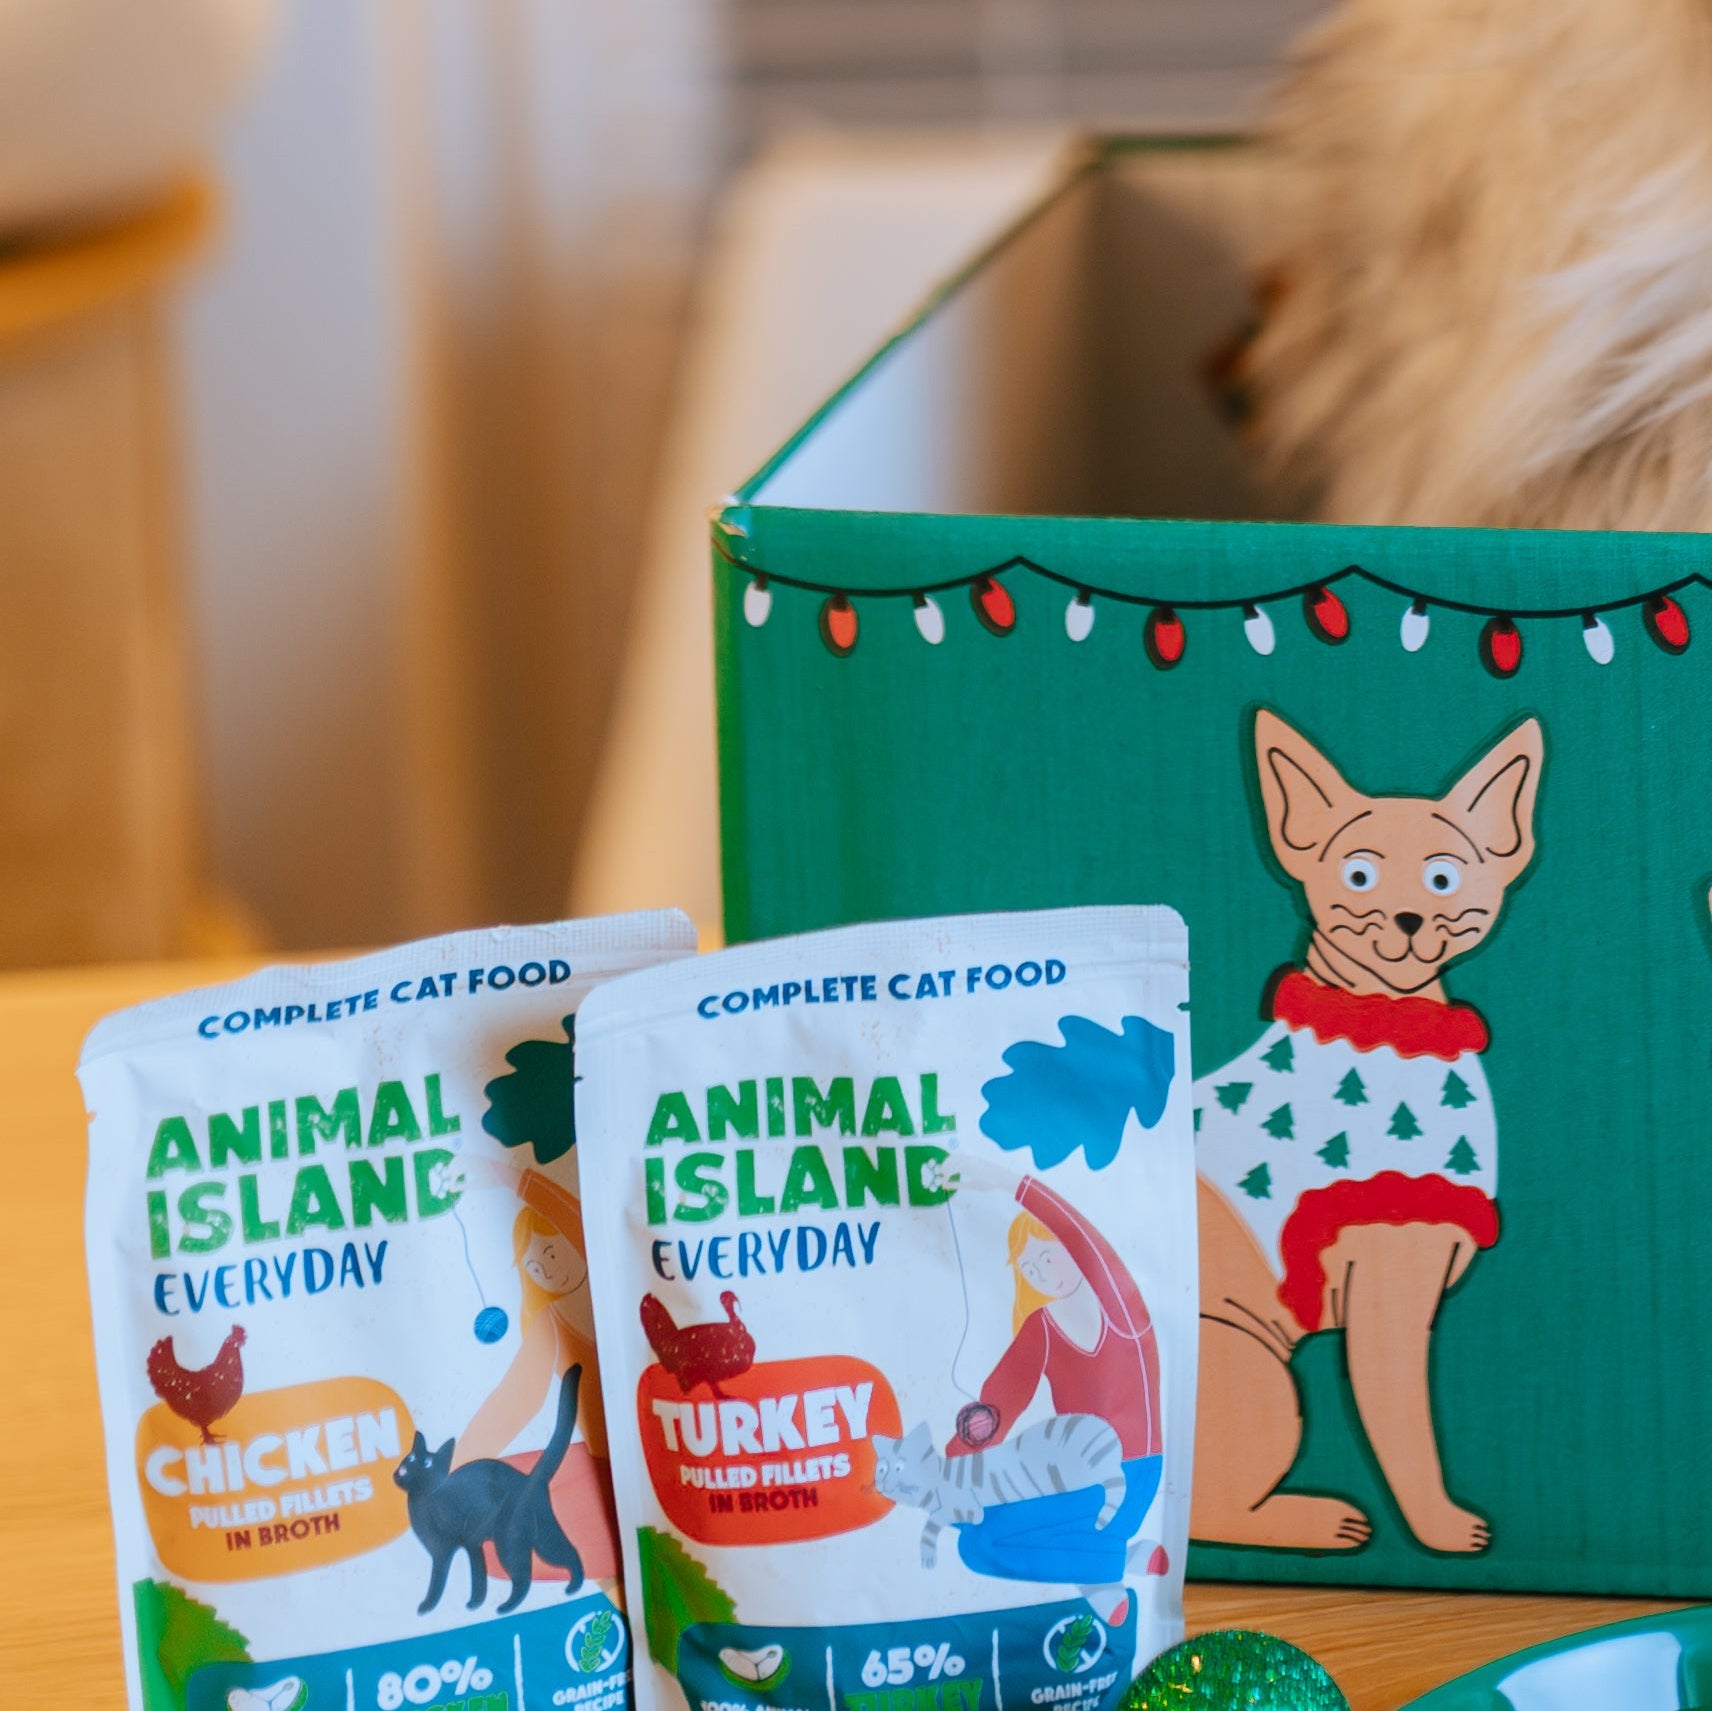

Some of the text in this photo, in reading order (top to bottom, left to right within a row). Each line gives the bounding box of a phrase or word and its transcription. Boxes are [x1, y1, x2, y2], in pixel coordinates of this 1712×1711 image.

[198, 959, 571, 1039] COMPLETE CAT FOOD
[697, 959, 1067, 1019] COMPLETE CAT FOOD
[145, 1073, 461, 1182] ANIMAL
[645, 1073, 957, 1147] ANIMAL
[146, 1149, 464, 1260] ISLAND
[645, 1144, 961, 1226] ISLAND
[153, 1239, 388, 1316] EVERYDAY
[653, 1220, 882, 1281] EVERYDAY
[144, 1406, 401, 1497] CHICKEN
[652, 1382, 874, 1458] TURKEY
[189, 1475, 373, 1530] PULLED FILLETS
[679, 1452, 851, 1490] PULLED FILLETS
[709, 1488, 819, 1514] IN BROTH
[225, 1513, 340, 1552] IN BROTH
[376, 1656, 493, 1711] 80%
[861, 1642, 966, 1688] 65%
